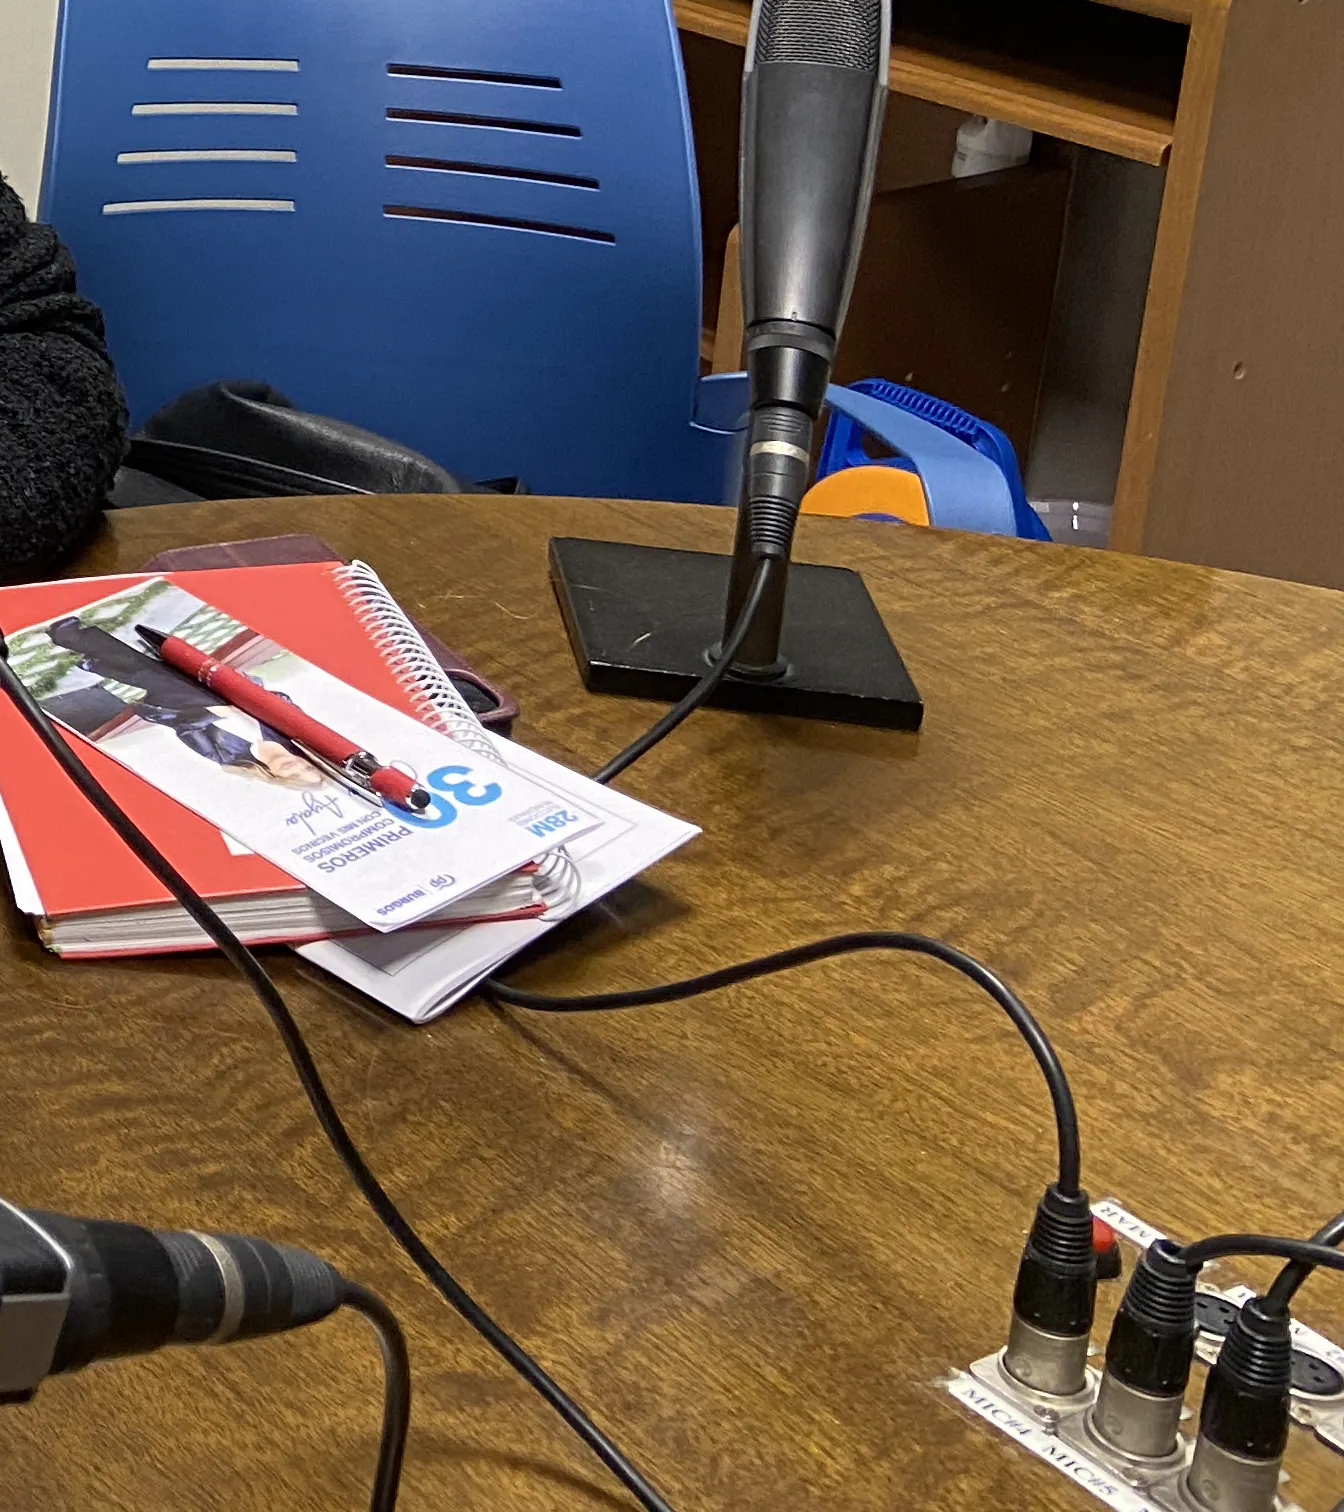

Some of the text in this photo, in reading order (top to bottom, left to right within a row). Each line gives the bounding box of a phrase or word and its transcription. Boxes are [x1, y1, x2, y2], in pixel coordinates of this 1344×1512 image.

[285, 790, 344, 837] Ayala
[358, 810, 382, 826] CON
[382, 765, 502, 829] 30
[303, 818, 395, 863] COMPROMISOS
[524, 809, 579, 838] 28M
[317, 825, 413, 873] PRIMEROS
[376, 889, 425, 916] BURGOS
